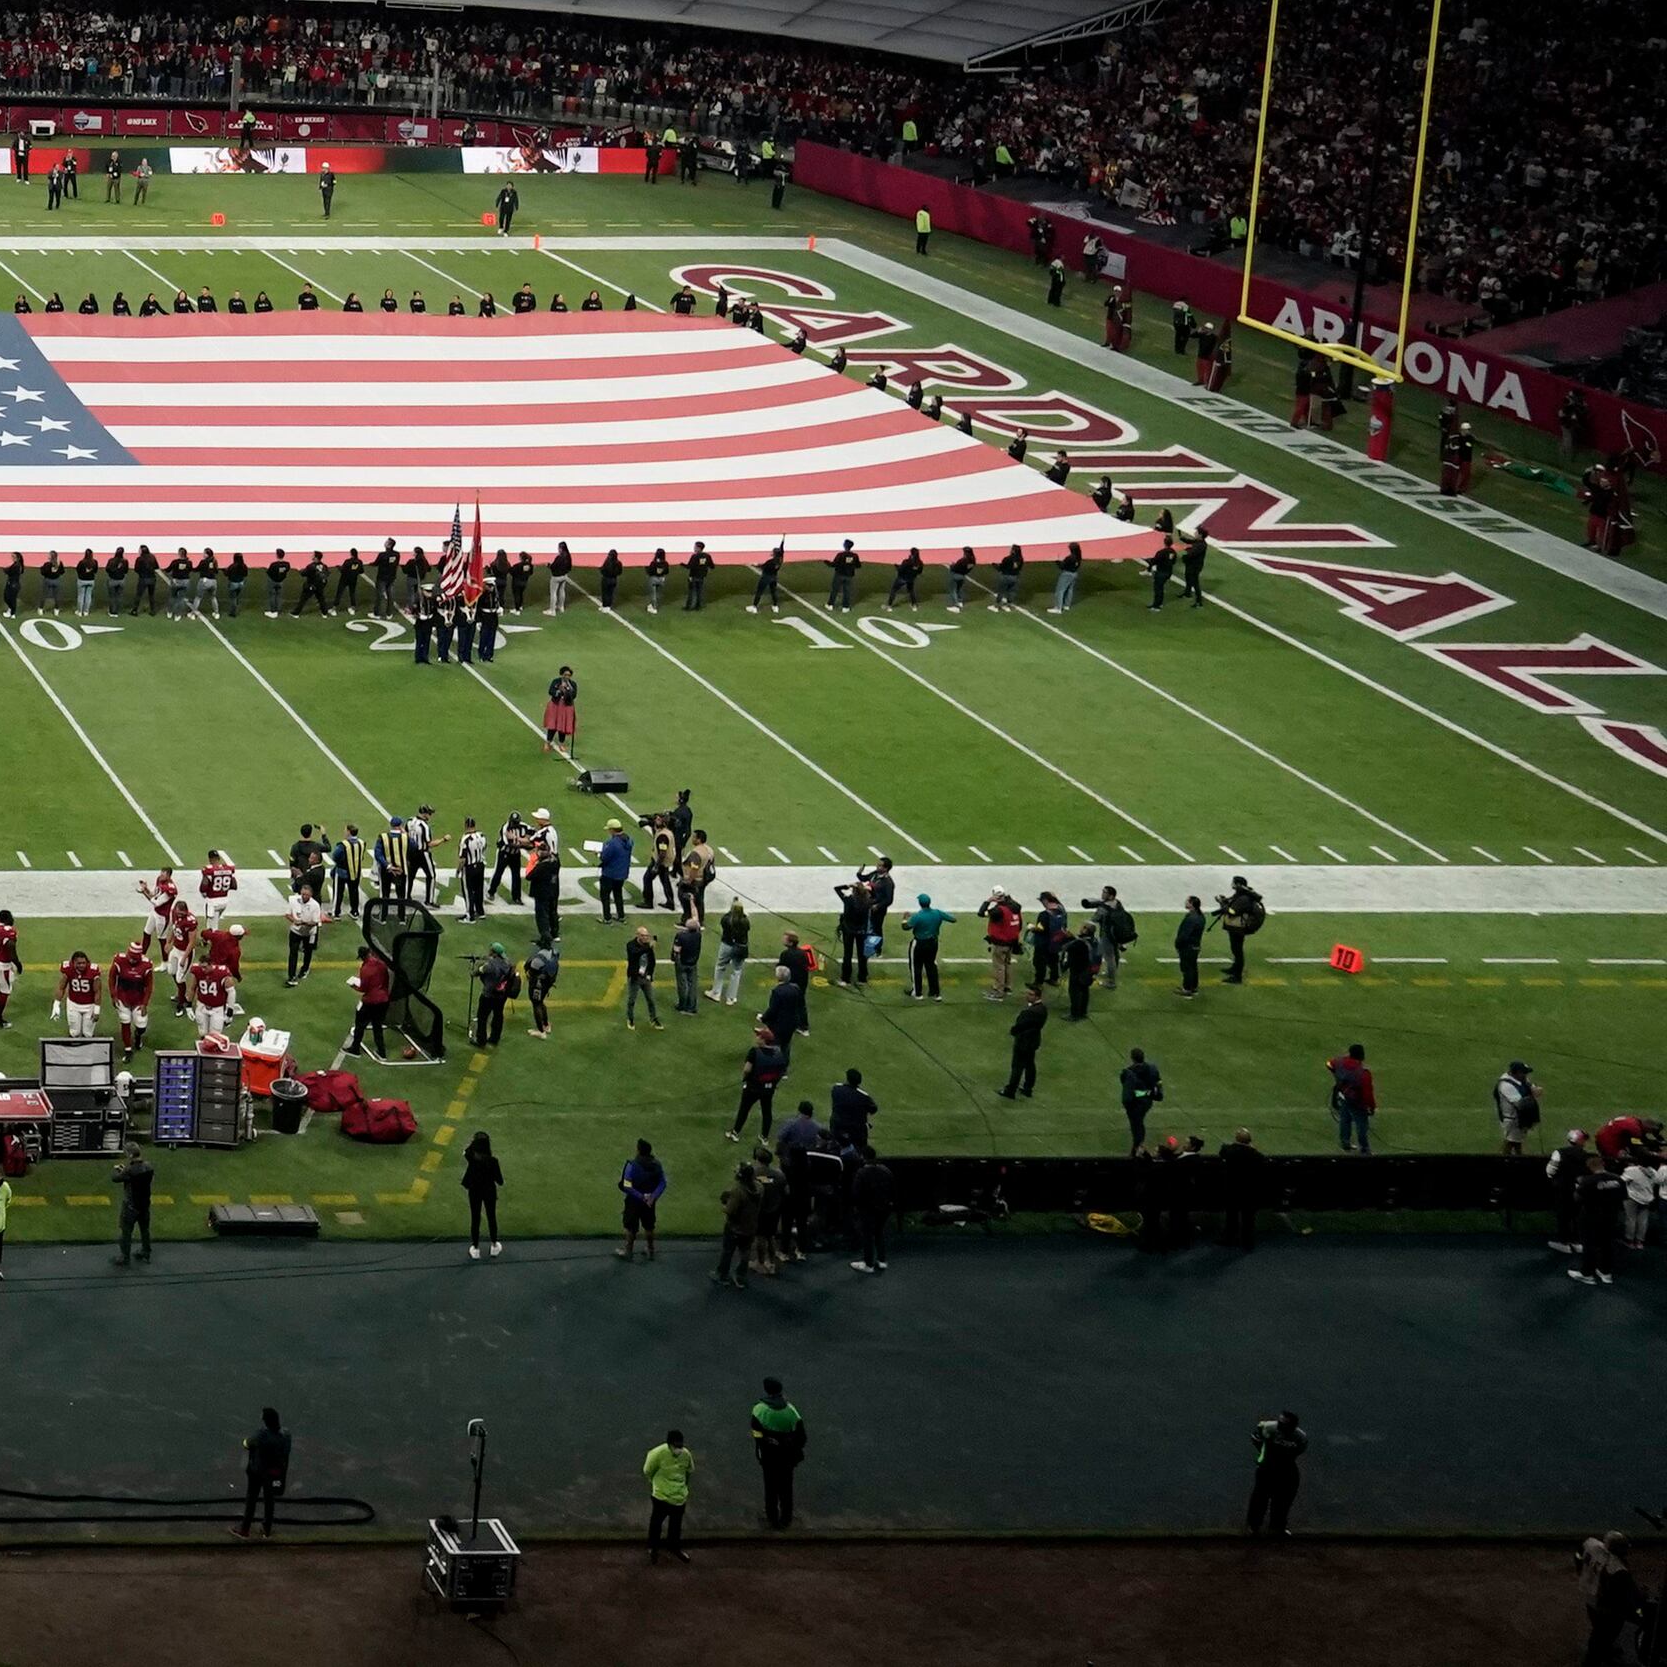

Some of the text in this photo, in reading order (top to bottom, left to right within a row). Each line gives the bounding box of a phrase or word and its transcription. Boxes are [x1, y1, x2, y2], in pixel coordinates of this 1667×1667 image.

[1176, 396, 1533, 535] END RACISM
[773, 614, 931, 650] 10
[213, 876, 233, 891] 89
[1337, 948, 1355, 969] 10
[71, 979, 91, 994] 95
[199, 981, 217, 997] 94
